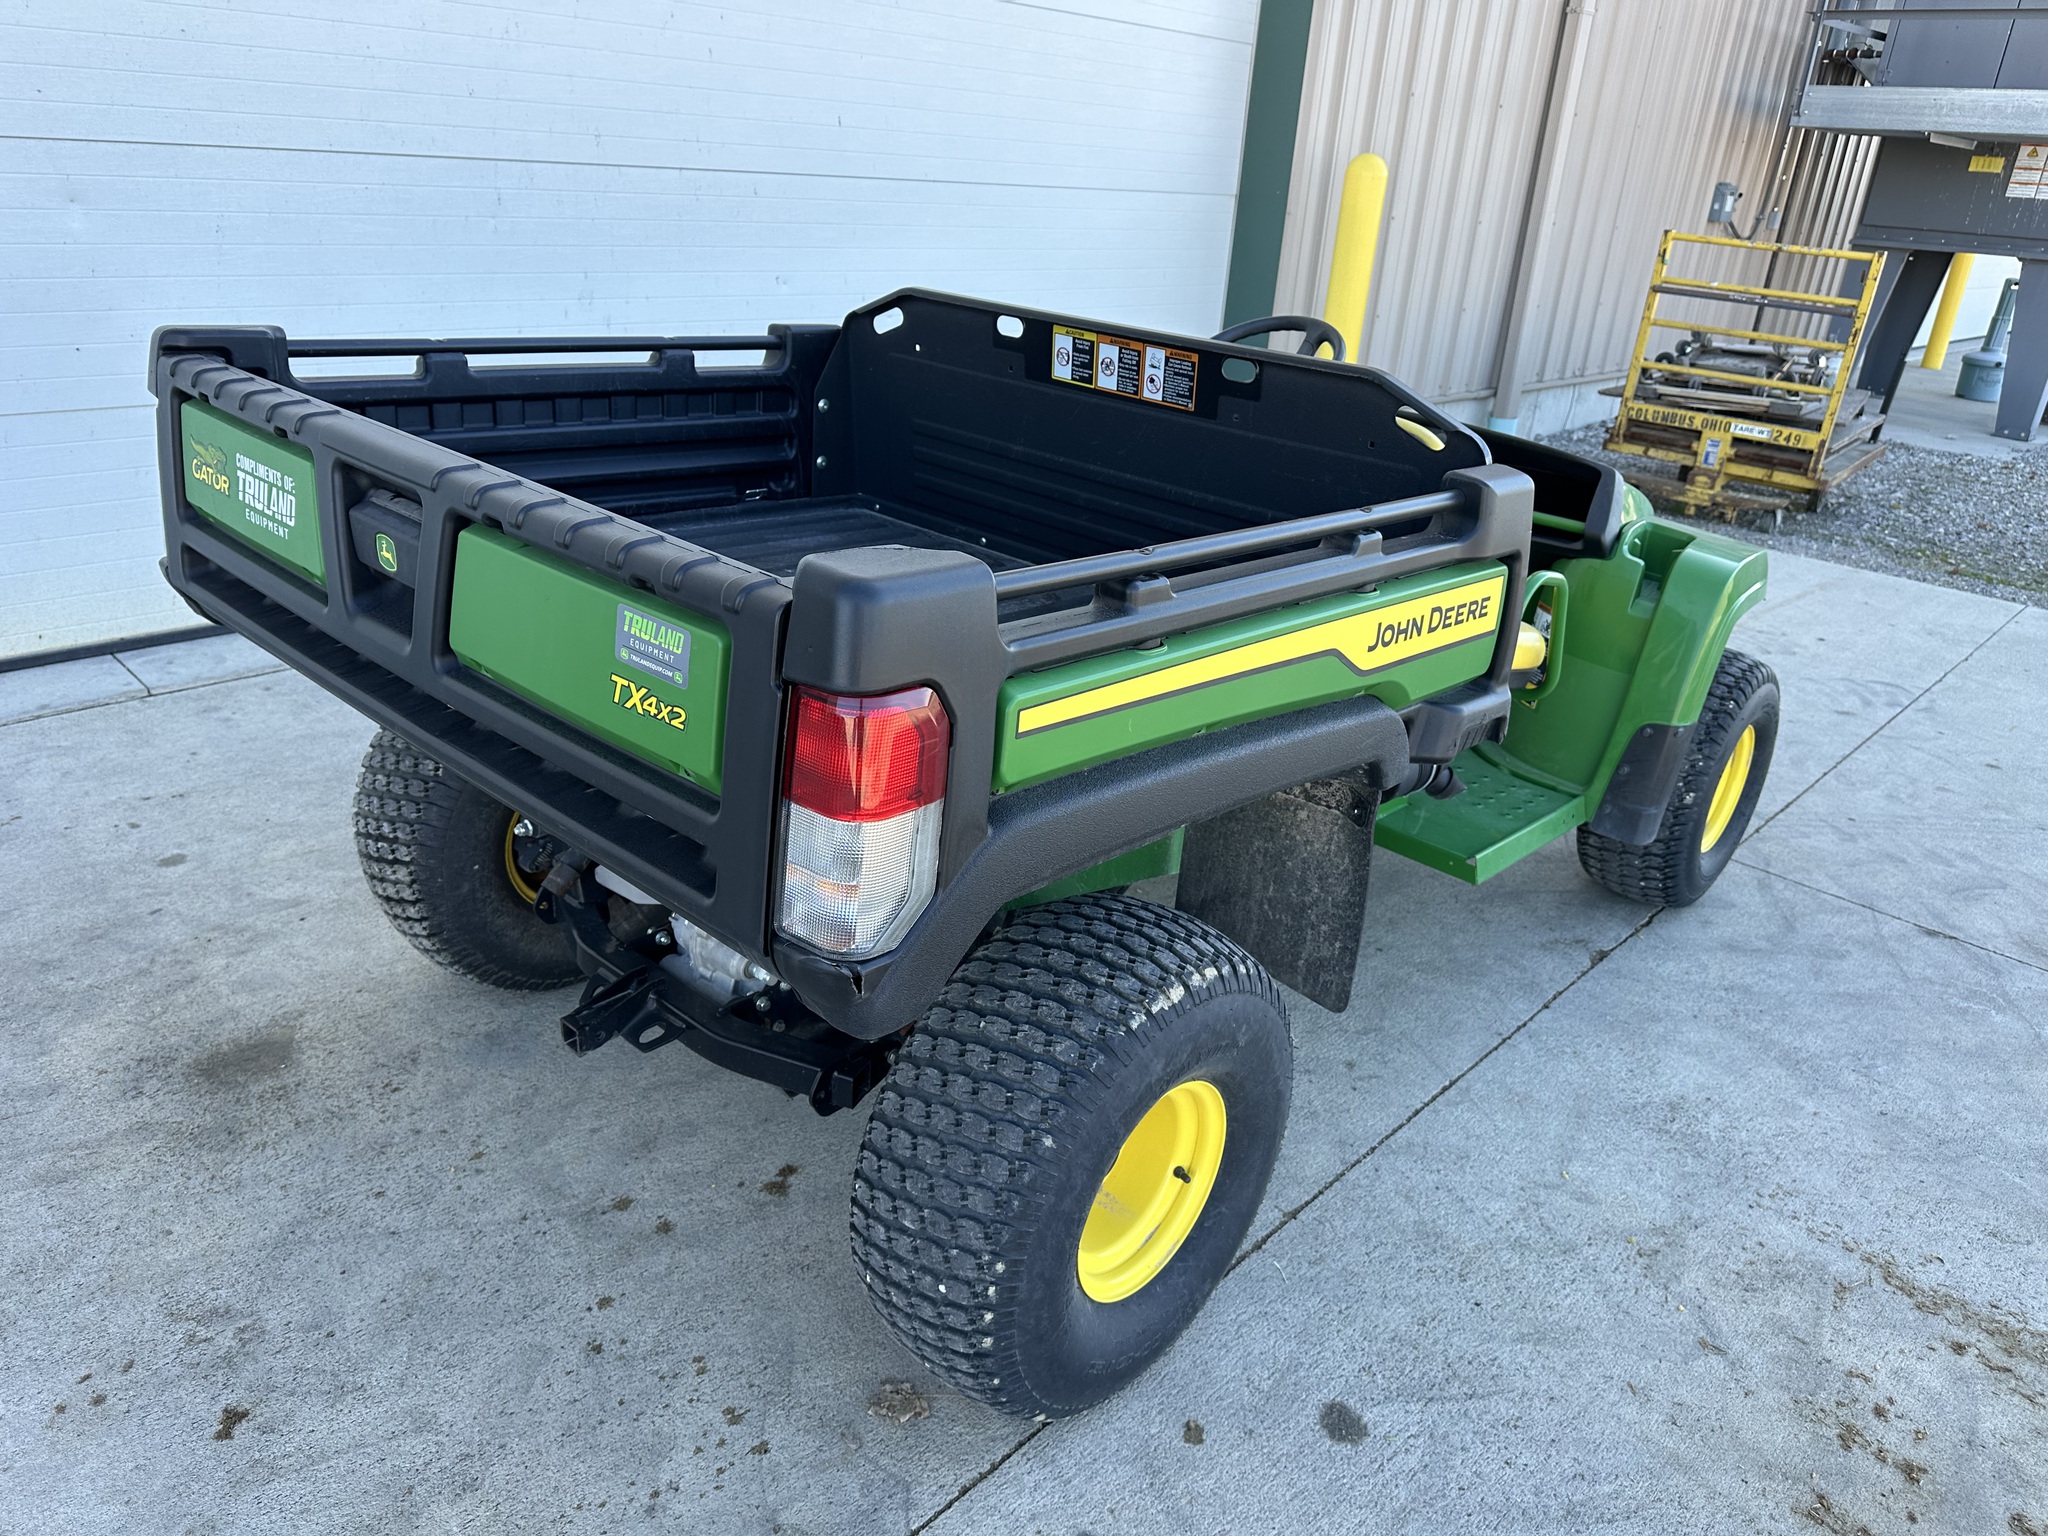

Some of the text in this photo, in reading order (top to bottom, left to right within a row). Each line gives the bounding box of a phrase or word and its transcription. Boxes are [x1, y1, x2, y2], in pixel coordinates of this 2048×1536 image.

[1701, 417, 1732, 434] OHIO
[191, 458, 230, 496] GATOR
[236, 452, 296, 494] COMPLIMENTS OF:
[236, 469, 296, 527] TRULAND
[245, 508, 289, 540] EQUIPMENT
[623, 610, 685, 655] TRULAND
[1367, 596, 1491, 653] JOHN DEERE
[629, 637, 675, 663] EQUIPMENT
[629, 653, 674, 678] TRULANDEQUIP.COM
